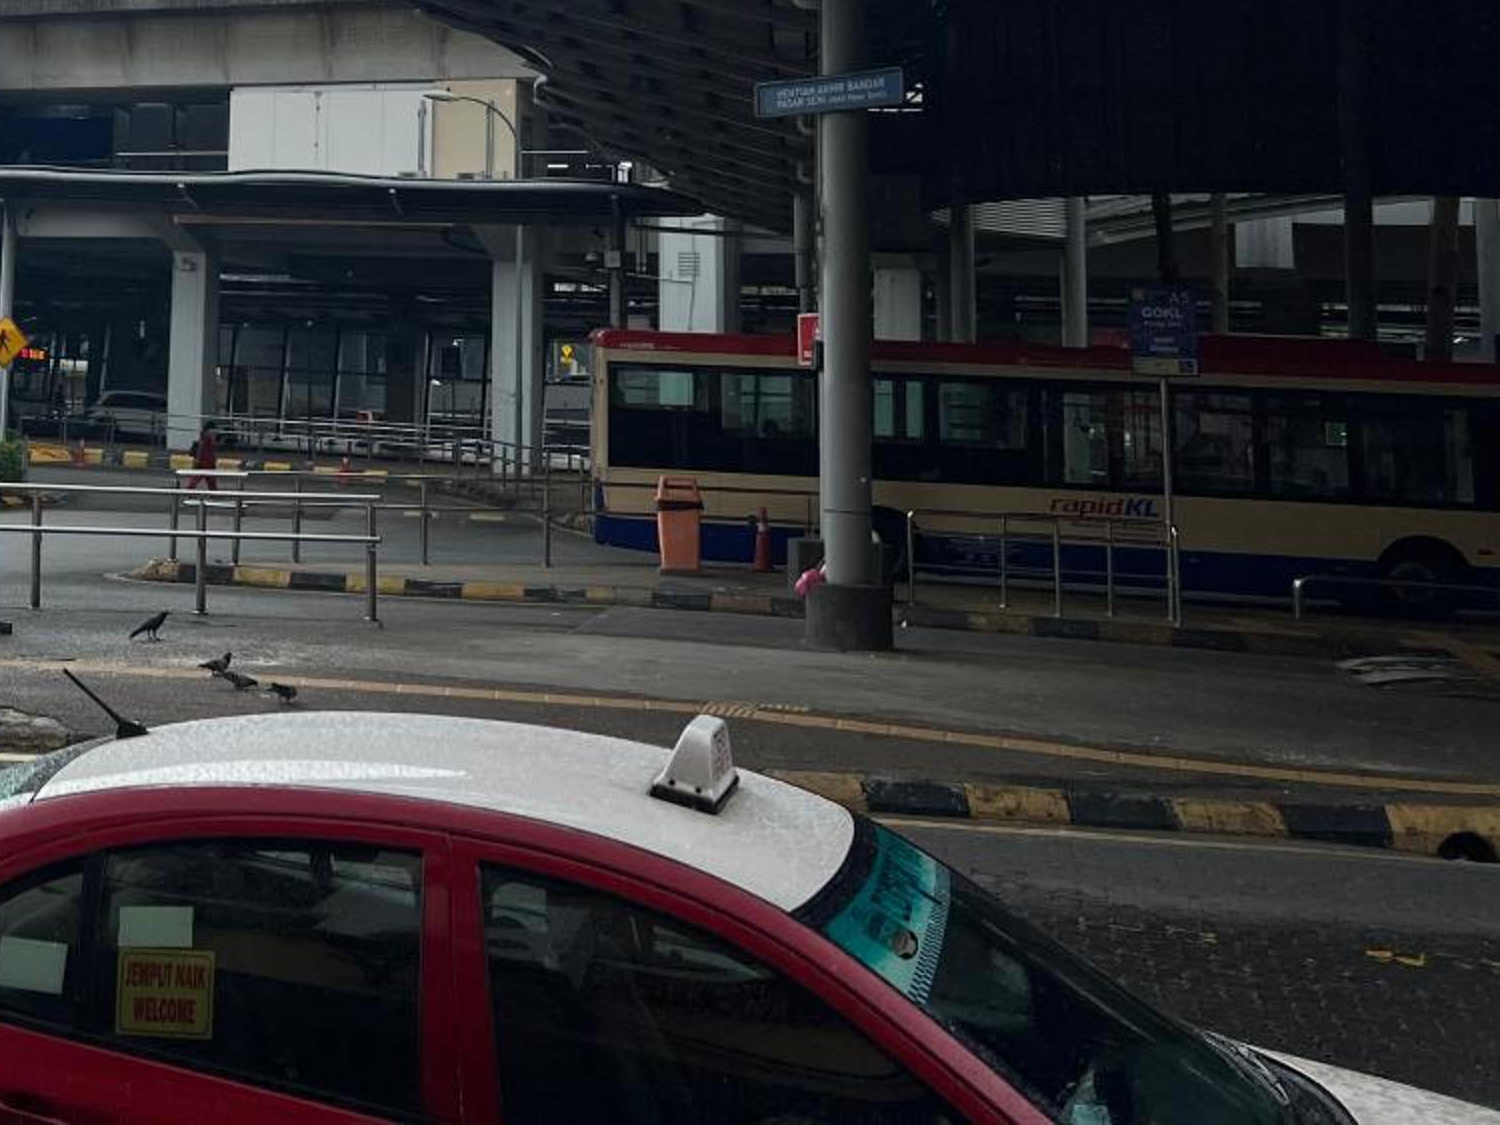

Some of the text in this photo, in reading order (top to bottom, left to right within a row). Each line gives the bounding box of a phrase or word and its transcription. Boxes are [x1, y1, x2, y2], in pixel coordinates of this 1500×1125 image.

[1050, 497, 1160, 521] rapidKL
[125, 961, 206, 988] JEMPUT NAIK
[132, 996, 197, 1024] WELCOME
